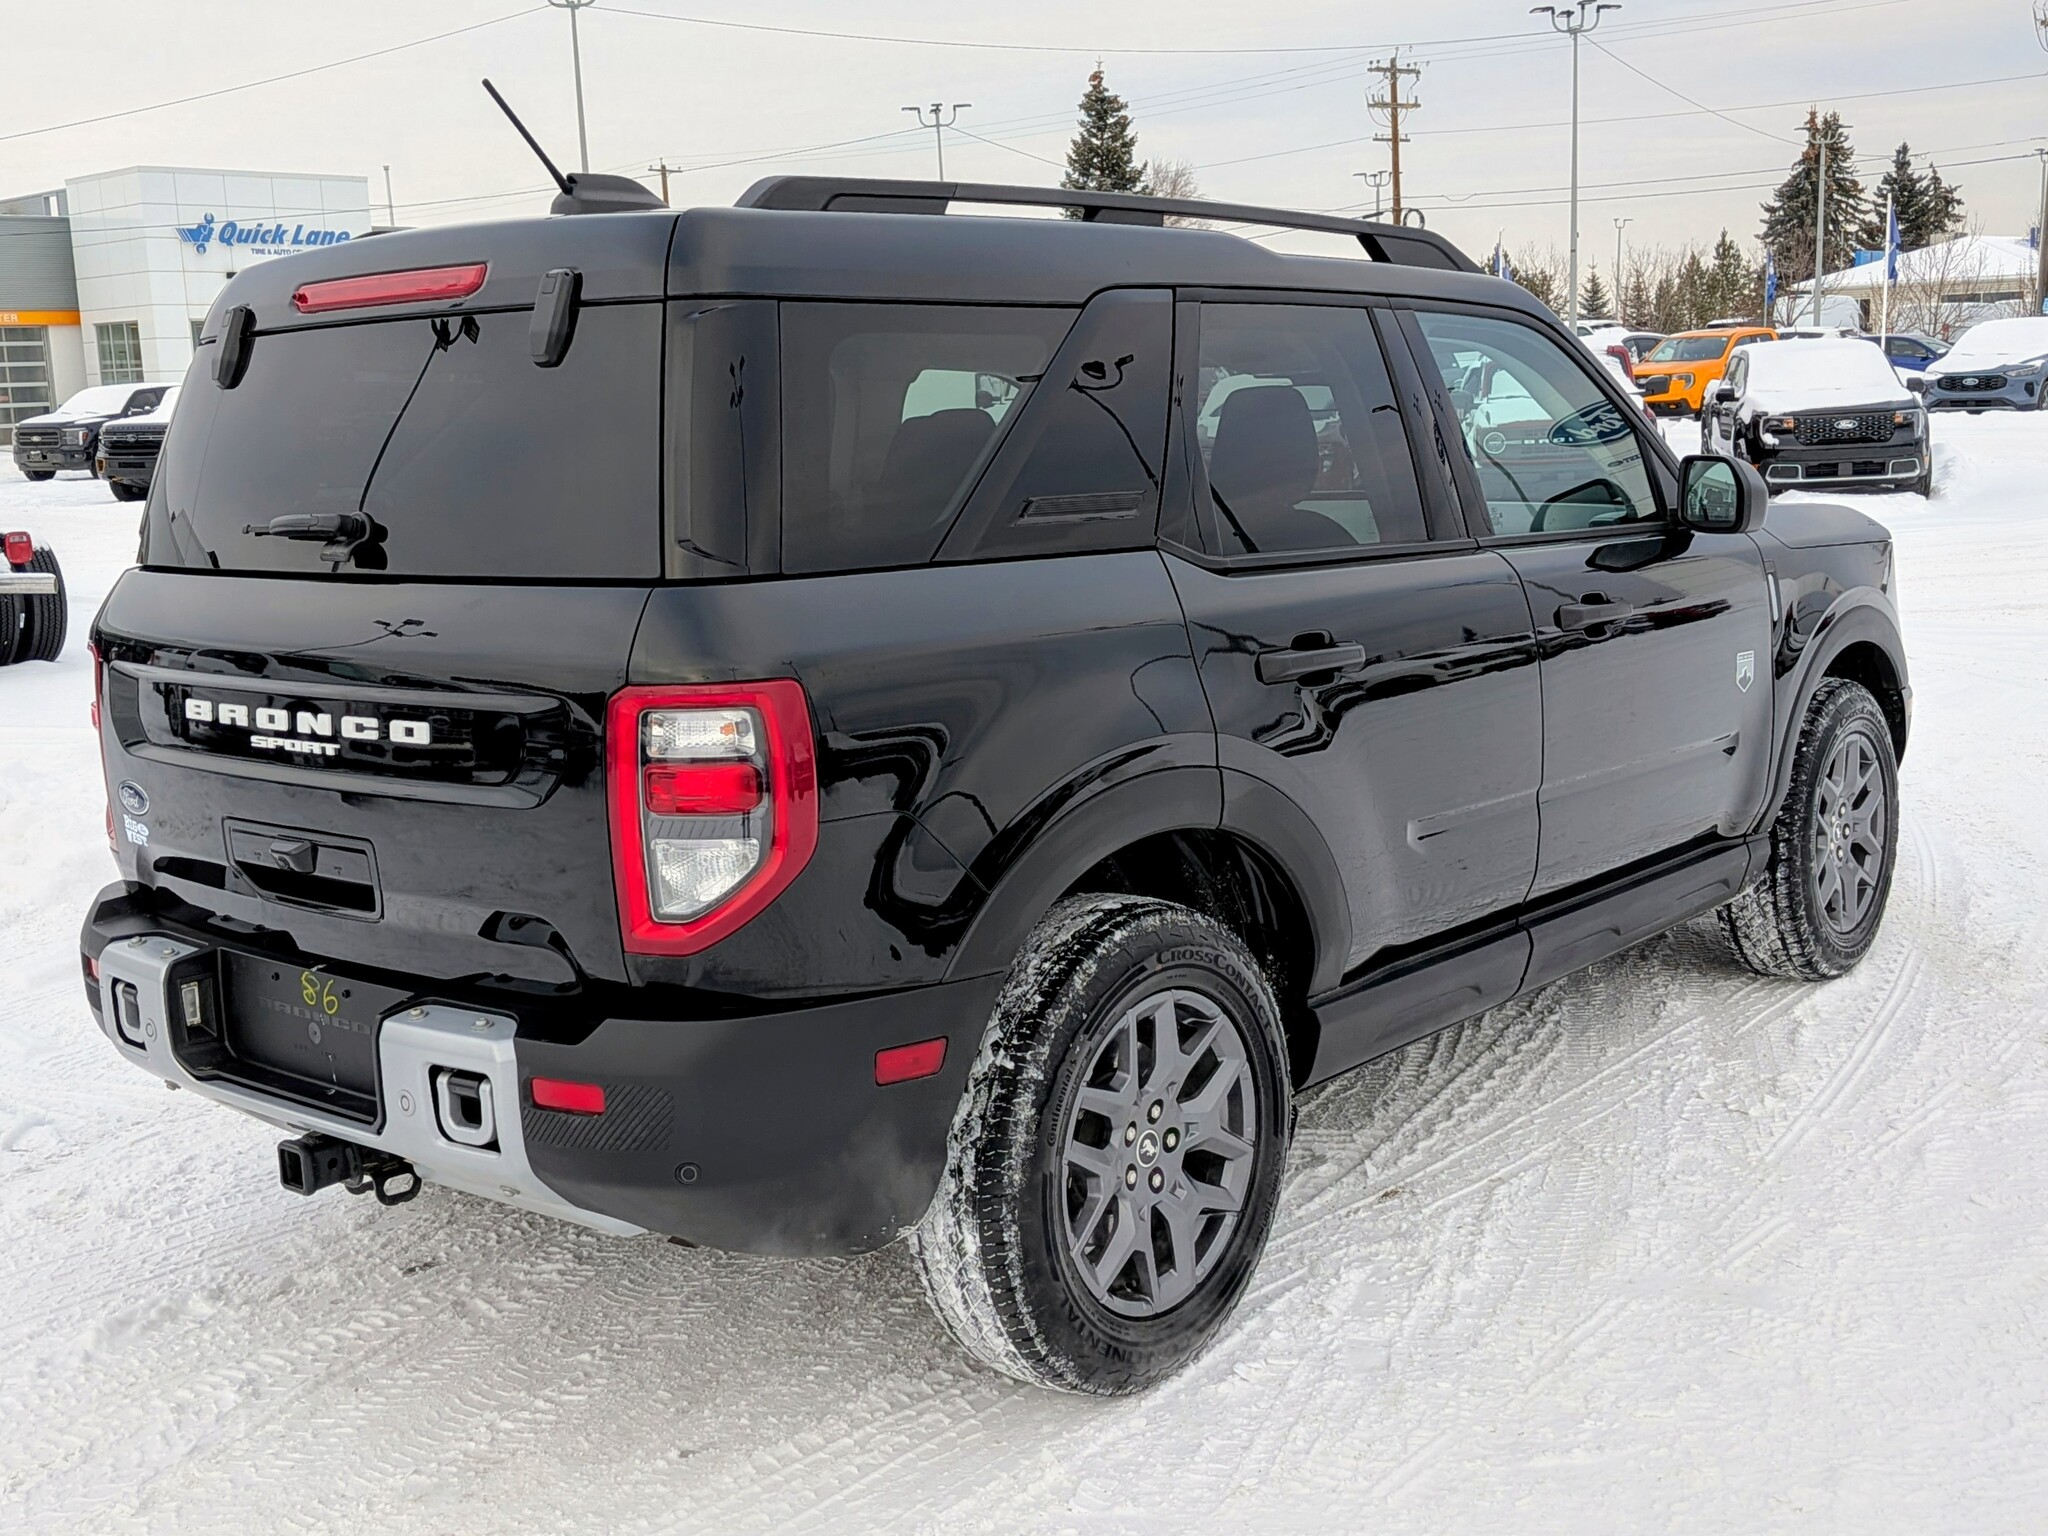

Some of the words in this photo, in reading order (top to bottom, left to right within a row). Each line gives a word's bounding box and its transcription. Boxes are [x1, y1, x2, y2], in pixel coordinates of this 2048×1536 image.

[218, 221, 289, 247] Quick
[290, 224, 351, 246] Lane
[185, 698, 431, 746] BRONCO
[250, 735, 341, 756] SPORT
[125, 828, 149, 848] WEST
[301, 971, 339, 1014] 86
